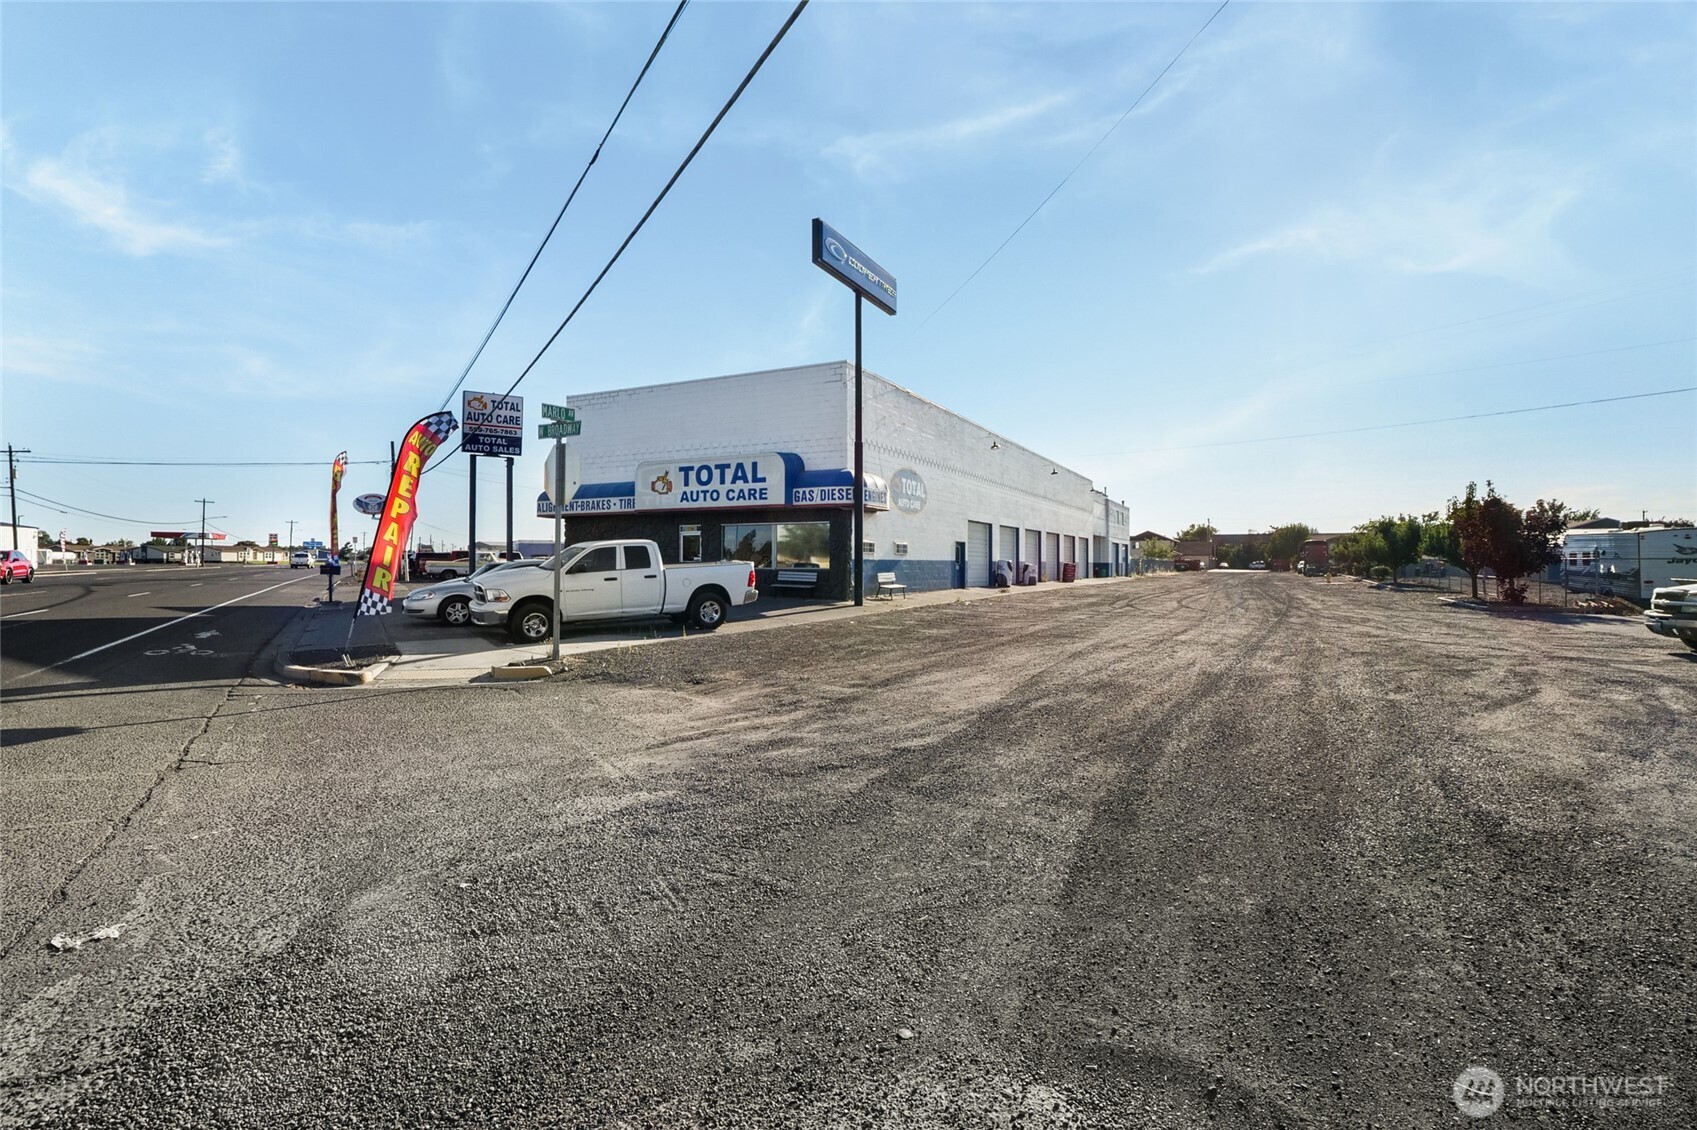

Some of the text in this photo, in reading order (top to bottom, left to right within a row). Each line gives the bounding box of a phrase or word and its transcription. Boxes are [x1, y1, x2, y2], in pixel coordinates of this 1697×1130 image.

[491, 399, 521, 412] TOTAL
[542, 405, 565, 419] MARLO
[466, 411, 521, 426] AUTO CARE
[547, 422, 580, 436] BROADWAY
[408, 431, 437, 456] AUTO
[479, 436, 508, 445] TOTAL
[464, 444, 520, 454] AUTO SALES
[678, 461, 767, 488] TOTAL
[680, 487, 768, 503] AUTO CARE
[794, 487, 855, 503] GAS/DIESE
[901, 477, 926, 498] TOTAL
[372, 451, 420, 592] REPAIR
